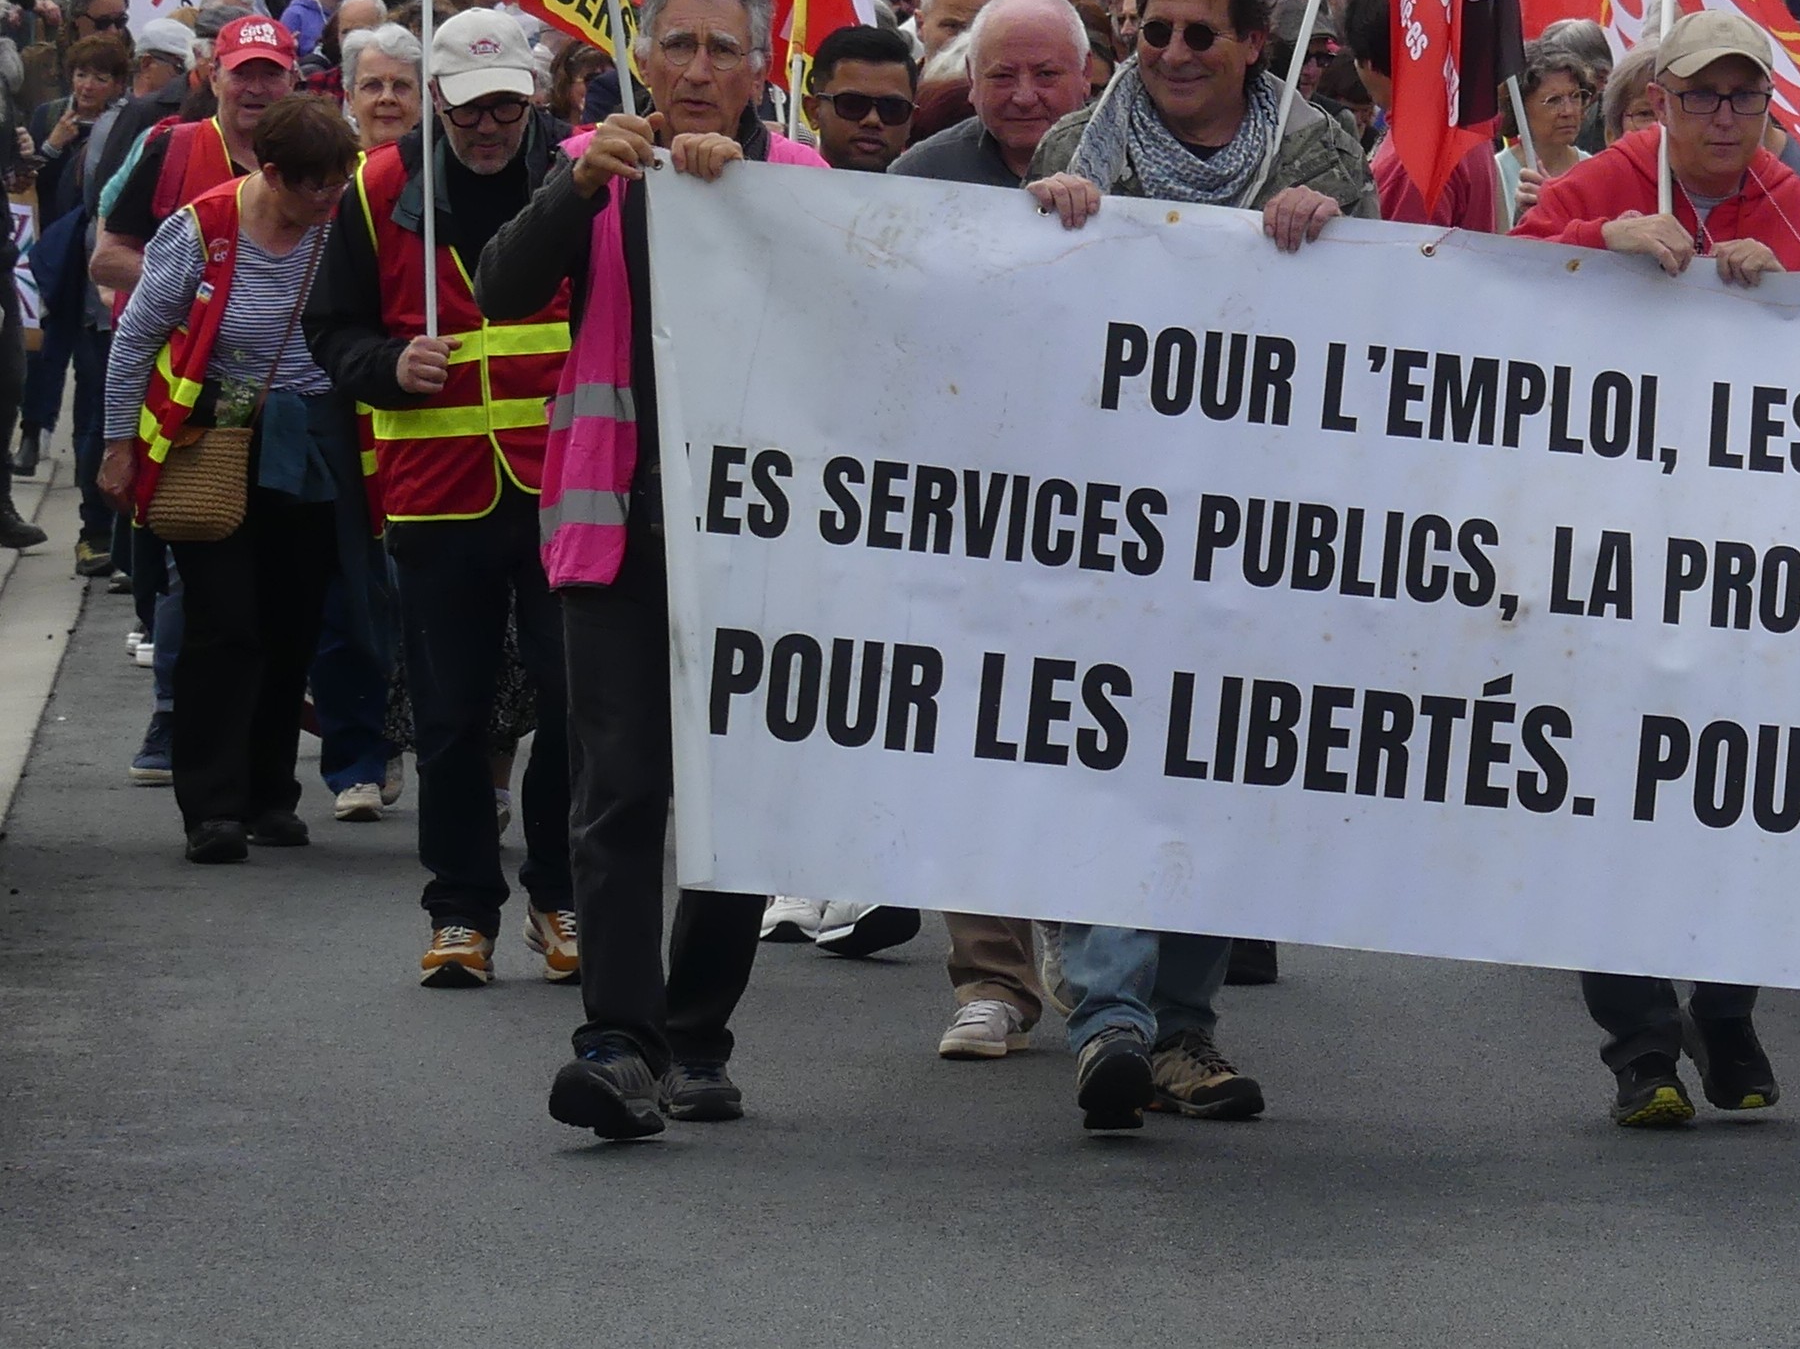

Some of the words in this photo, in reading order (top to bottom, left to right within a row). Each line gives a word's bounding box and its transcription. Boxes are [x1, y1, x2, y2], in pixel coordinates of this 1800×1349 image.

[1101, 322, 1296, 427] POUR
[1321, 343, 1678, 475] L'EMPLOI,
[686, 442, 793, 539] ES
[819, 456, 1168, 577] SERVICES
[1193, 493, 1519, 622] PUBLICS,
[1549, 526, 1633, 620] LA
[709, 627, 944, 754] POUR
[974, 651, 1133, 771] LES
[1163, 670, 1596, 817] LIBERTÉS.
